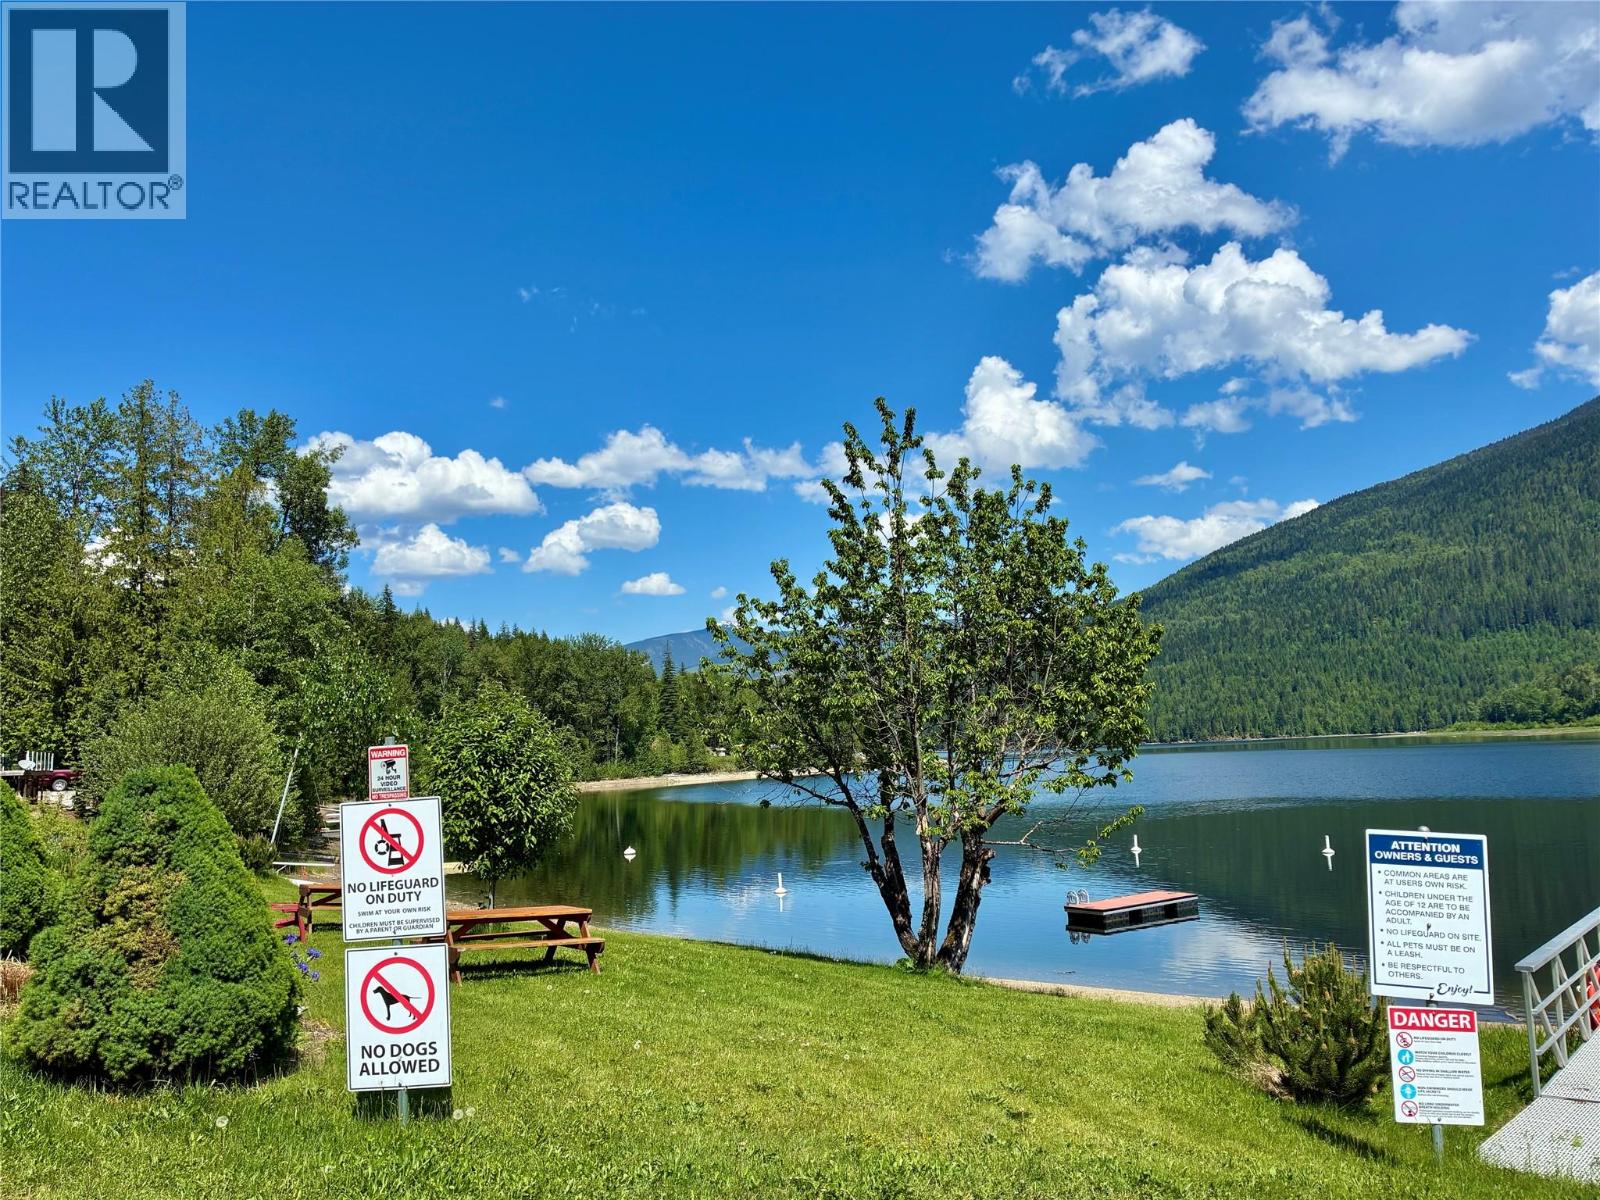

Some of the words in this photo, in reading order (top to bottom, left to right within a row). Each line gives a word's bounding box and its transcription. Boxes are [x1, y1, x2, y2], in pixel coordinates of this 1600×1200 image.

[371, 750, 405, 758] WARNING
[1391, 840, 1460, 853] ATTENTION
[1375, 850, 1422, 862] OWNERS
[1425, 853, 1432, 862] &
[1434, 854, 1478, 864] GUESTS
[1384, 870, 1421, 878] COMMON
[348, 883, 366, 893] NO
[370, 877, 439, 892] LIFEGUARD
[366, 894, 386, 905] ON
[388, 891, 422, 903] DUTY
[1385, 891, 1425, 899] CHILDREN
[1386, 909, 1444, 918] ACCOMPANIED
[1400, 929, 1445, 938] LIFEGUARD
[1400, 963, 1452, 973] RESPECTFUL
[1388, 971, 1423, 980] OTHERS.
[1437, 982, 1473, 996] Enjoy!
[1394, 1012, 1471, 1028] DANGER
[362, 1045, 385, 1058] NO
[391, 1042, 437, 1057] DOGS
[360, 1059, 440, 1076] ALLOWED
